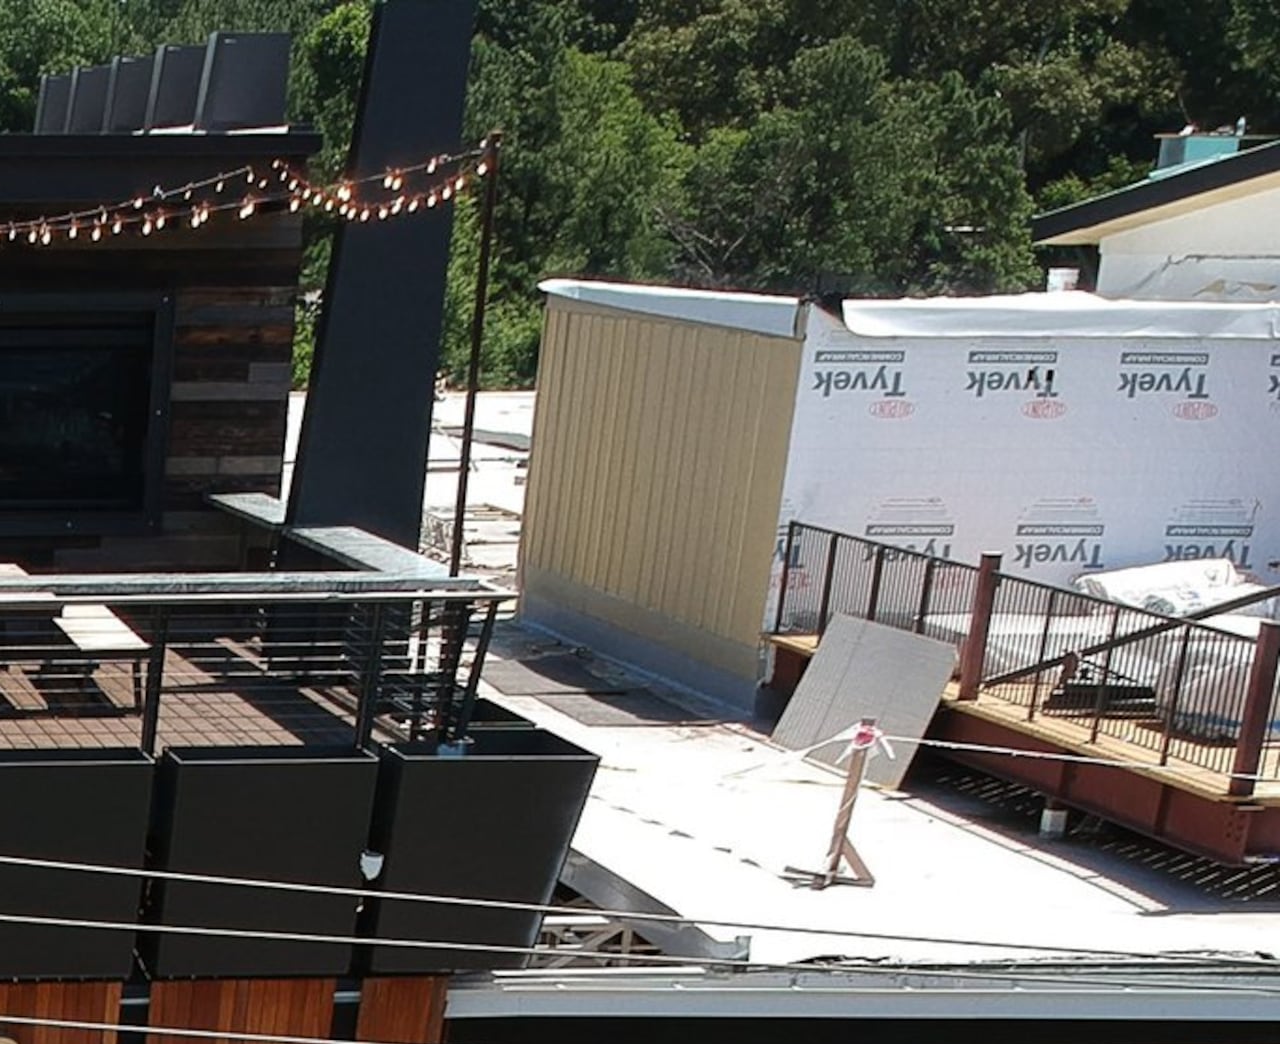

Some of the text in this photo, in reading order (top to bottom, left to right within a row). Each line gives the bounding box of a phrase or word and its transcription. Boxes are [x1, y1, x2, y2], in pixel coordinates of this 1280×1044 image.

[812, 366, 906, 397] Tyvek
[966, 366, 1059, 397] Tyvek
[1118, 367, 1209, 398] Tyvek
[1014, 538, 1104, 569] Tyvek
